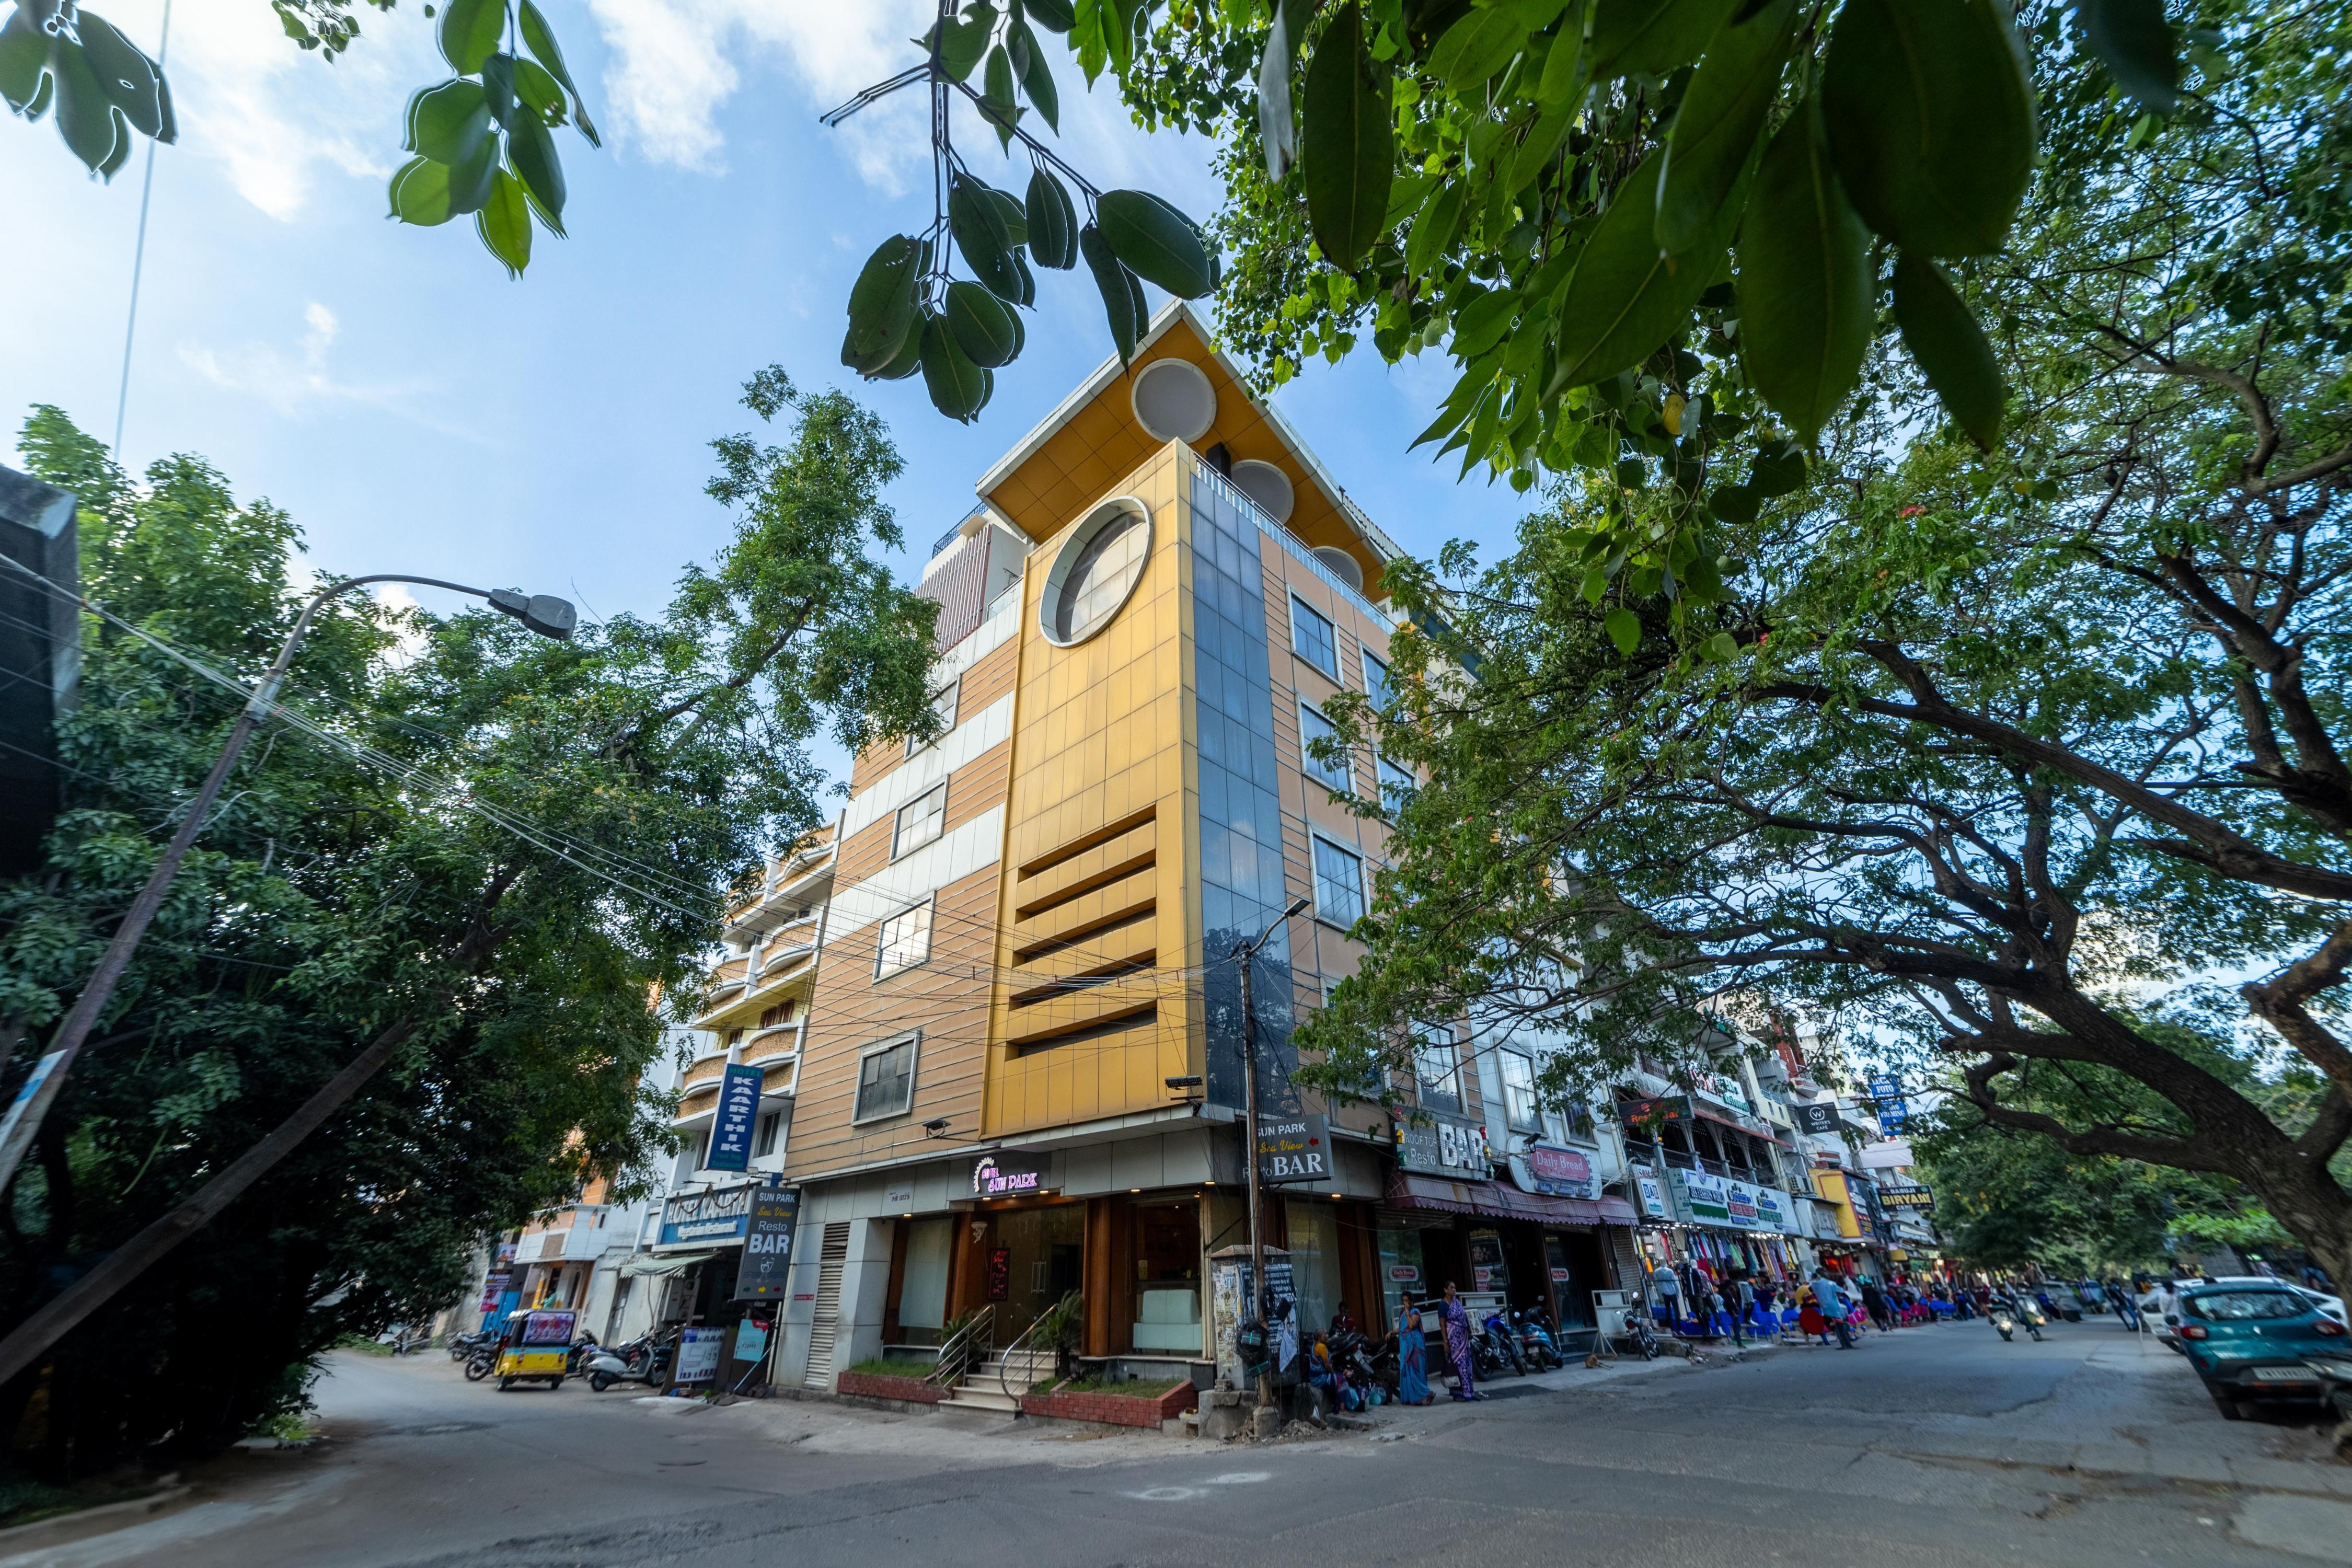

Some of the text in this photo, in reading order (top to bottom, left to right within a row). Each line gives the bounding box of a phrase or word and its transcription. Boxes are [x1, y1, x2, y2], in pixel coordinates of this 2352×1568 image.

[729, 1067, 762, 1077] HOTEL
[1876, 1085, 1894, 1093] FOTO
[720, 1077, 754, 1151] KAARTHIK
[1278, 1123, 1306, 1134] PARK
[1260, 1140, 1304, 1153] Sea View
[1405, 1133, 1437, 1147] ROOF TOP
[1438, 1123, 1488, 1171] BAR
[1411, 1148, 1436, 1166] Resto
[1536, 1151, 1584, 1171] Daily Bread
[1273, 1153, 1324, 1176] BAR
[982, 1167, 999, 1180] HOTEL
[1243, 1166, 1272, 1179] Rto
[988, 1173, 1037, 1192] SUN PARK
[759, 1192, 795, 1203] SUN PARK
[1642, 1183, 1660, 1200] BAR
[1881, 1193, 1932, 1206] BIRYANI
[666, 1197, 700, 1224] HOTEL
[757, 1206, 792, 1217] Sea View
[758, 1220, 788, 1232] Resto
[748, 1233, 790, 1254] BAR
